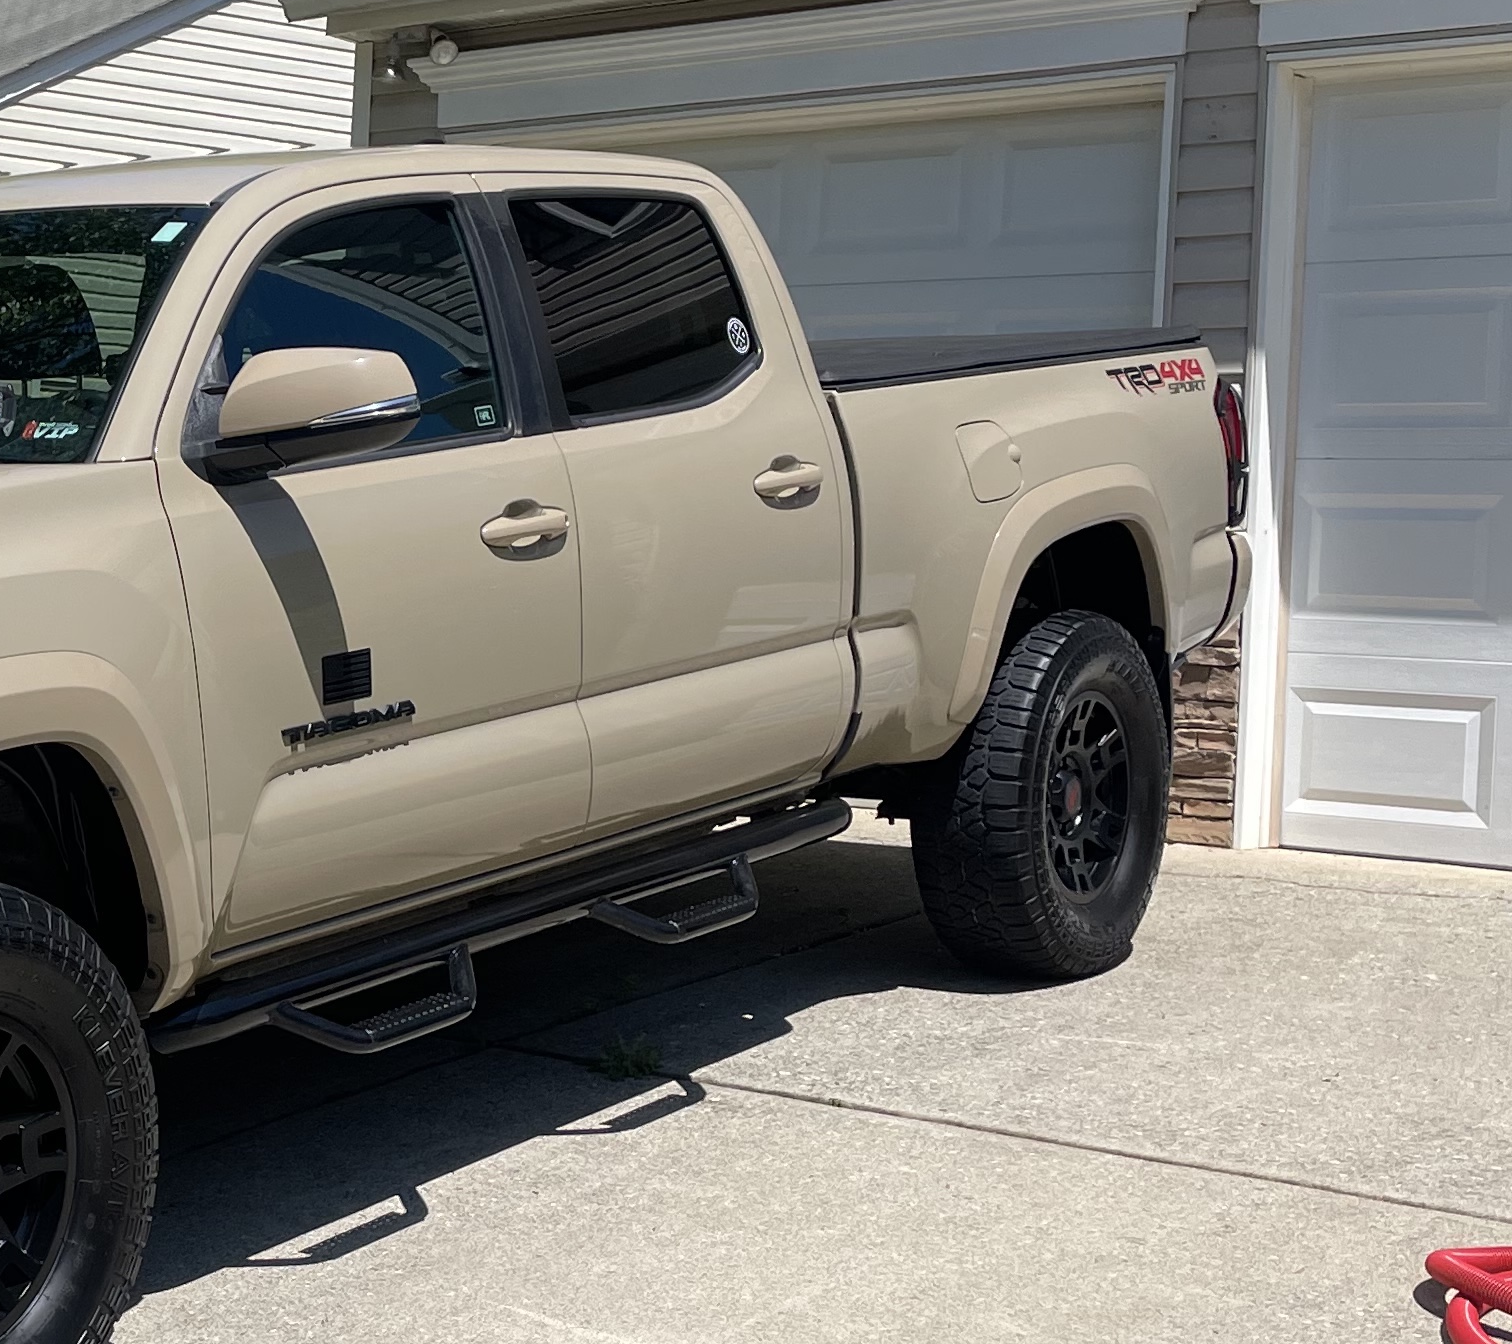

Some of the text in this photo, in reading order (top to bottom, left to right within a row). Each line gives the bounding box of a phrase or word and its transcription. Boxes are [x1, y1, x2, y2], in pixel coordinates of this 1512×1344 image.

[1105, 364, 1165, 397] TRD
[1168, 380, 1206, 394] SPORT
[33, 422, 79, 438] VIP
[281, 700, 416, 743] TACOMA
[72, 1003, 129, 1142] KLEVER
